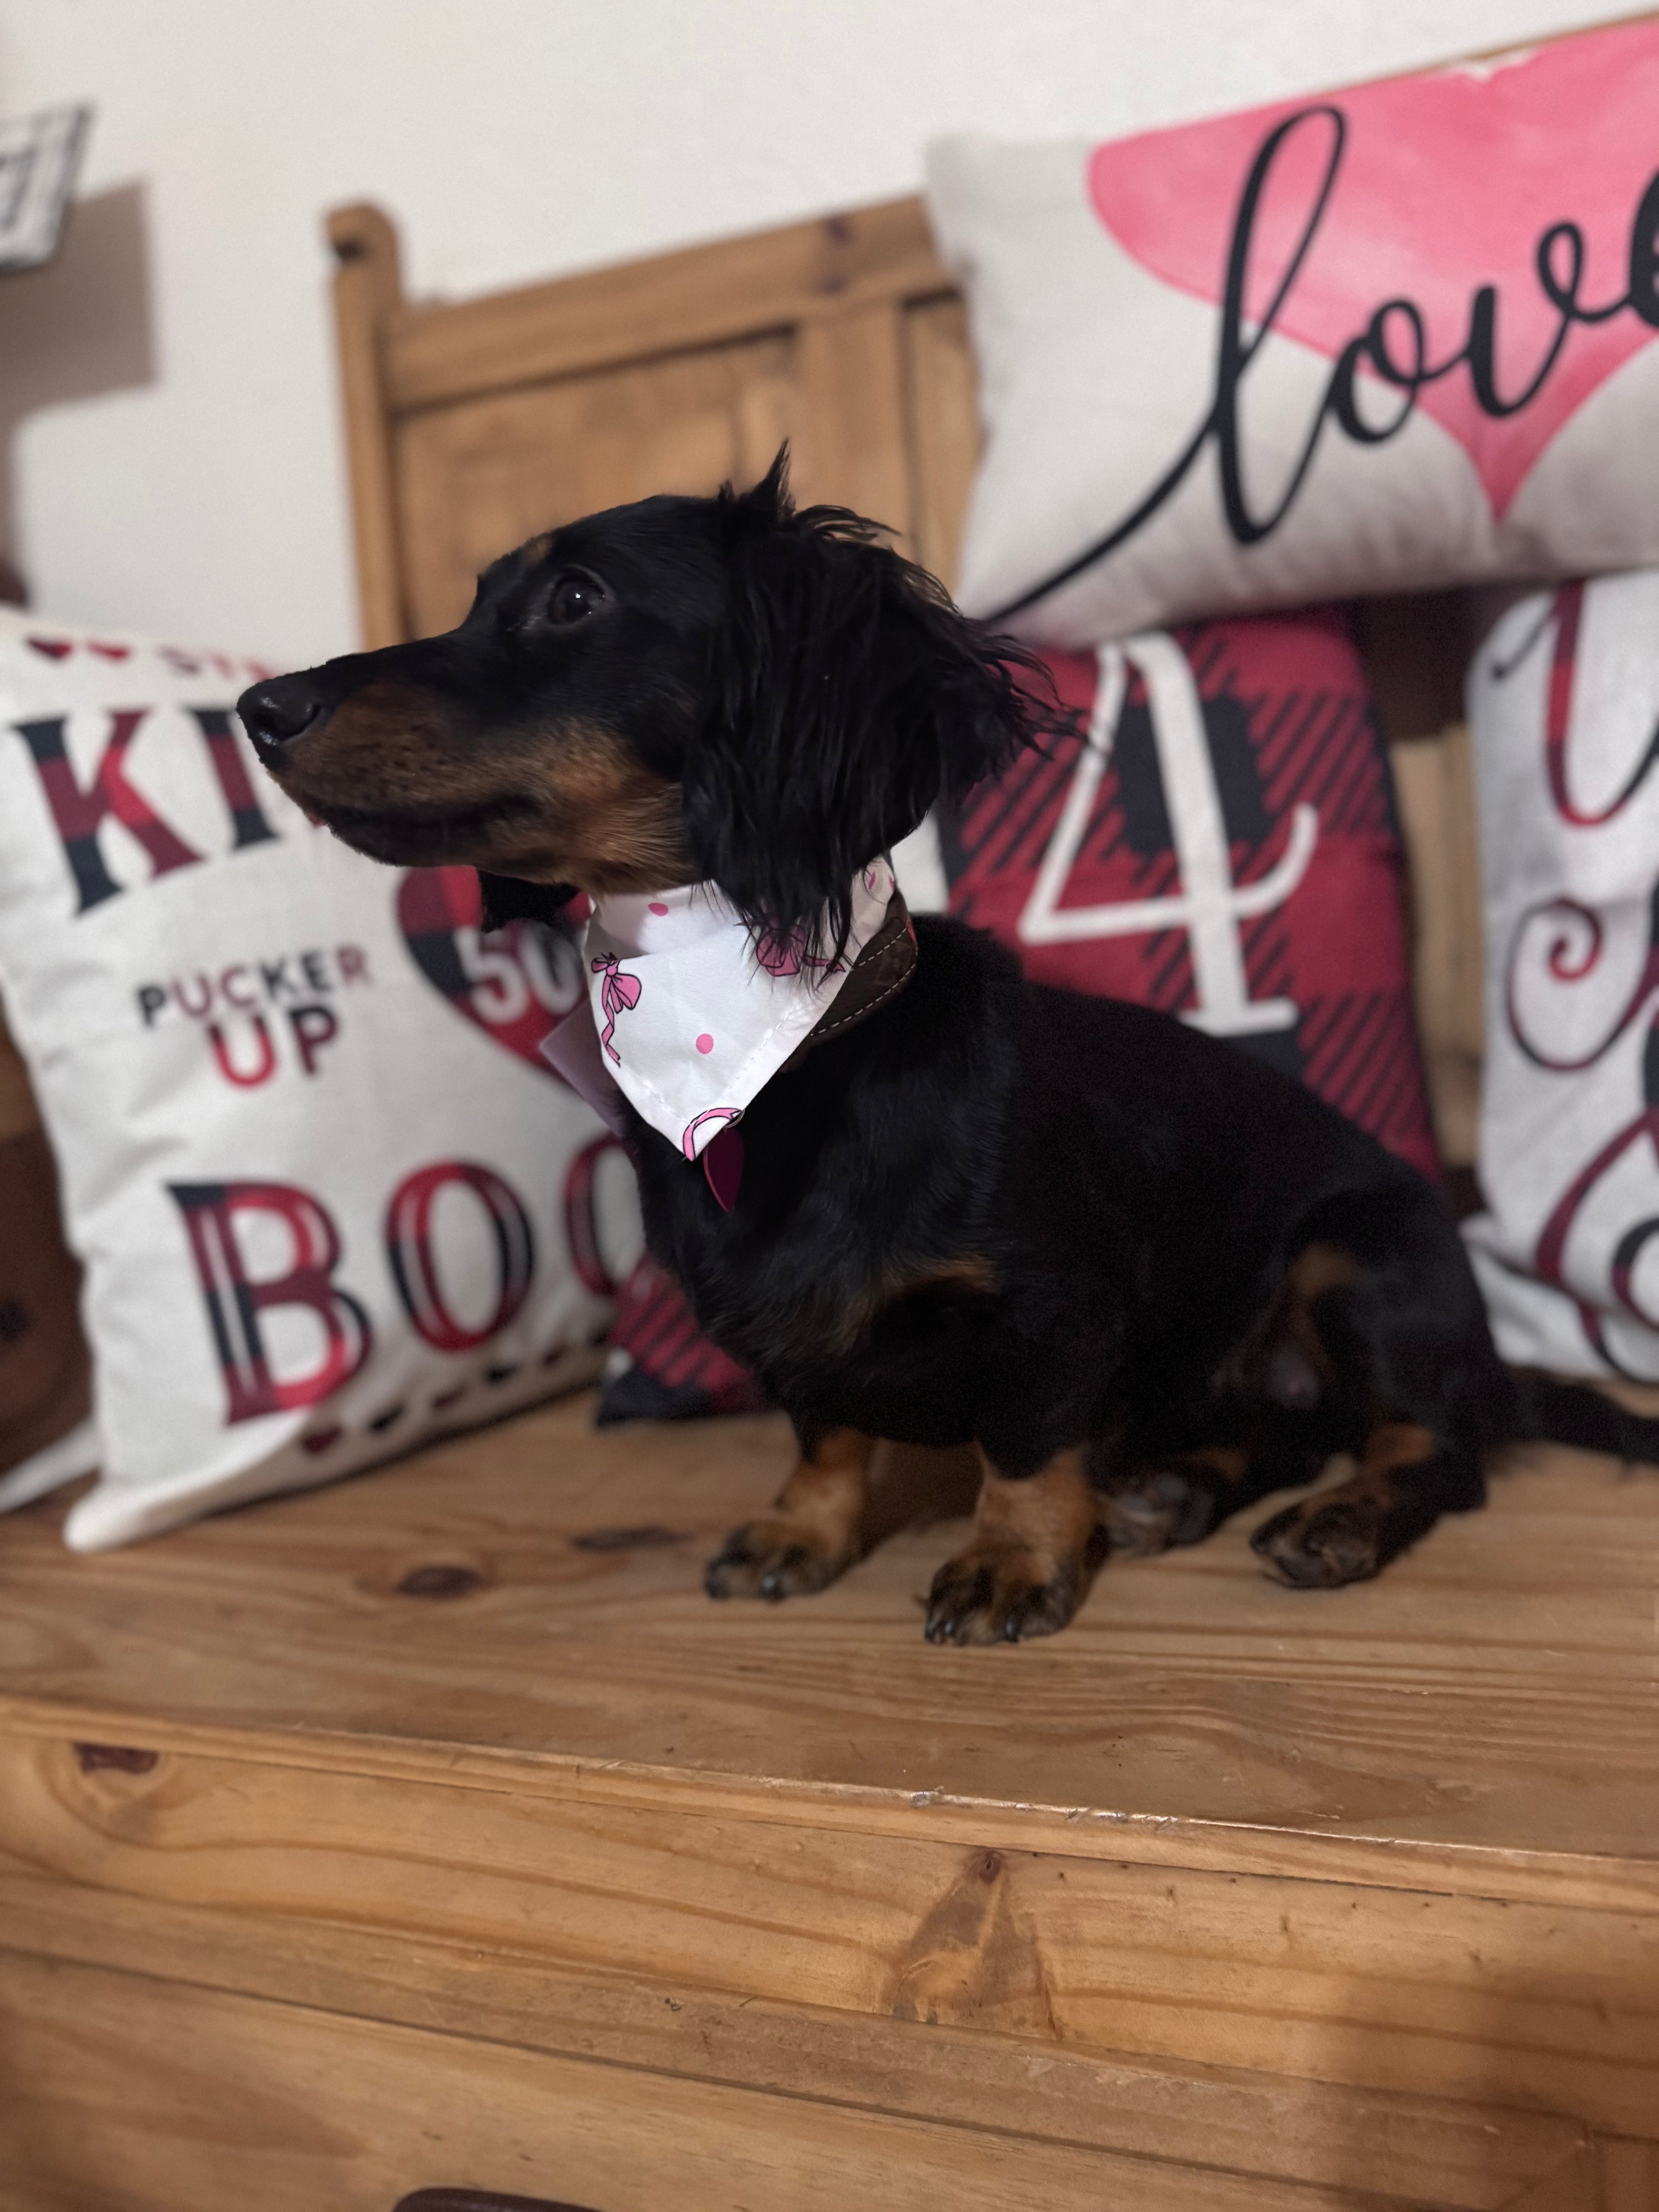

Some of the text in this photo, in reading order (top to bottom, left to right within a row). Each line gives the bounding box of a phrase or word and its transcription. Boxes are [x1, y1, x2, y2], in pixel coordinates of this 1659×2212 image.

[982, 104, 1659, 622] lov
[136, 944, 372, 1029] PUCKER
[207, 1006, 338, 1088] UP
